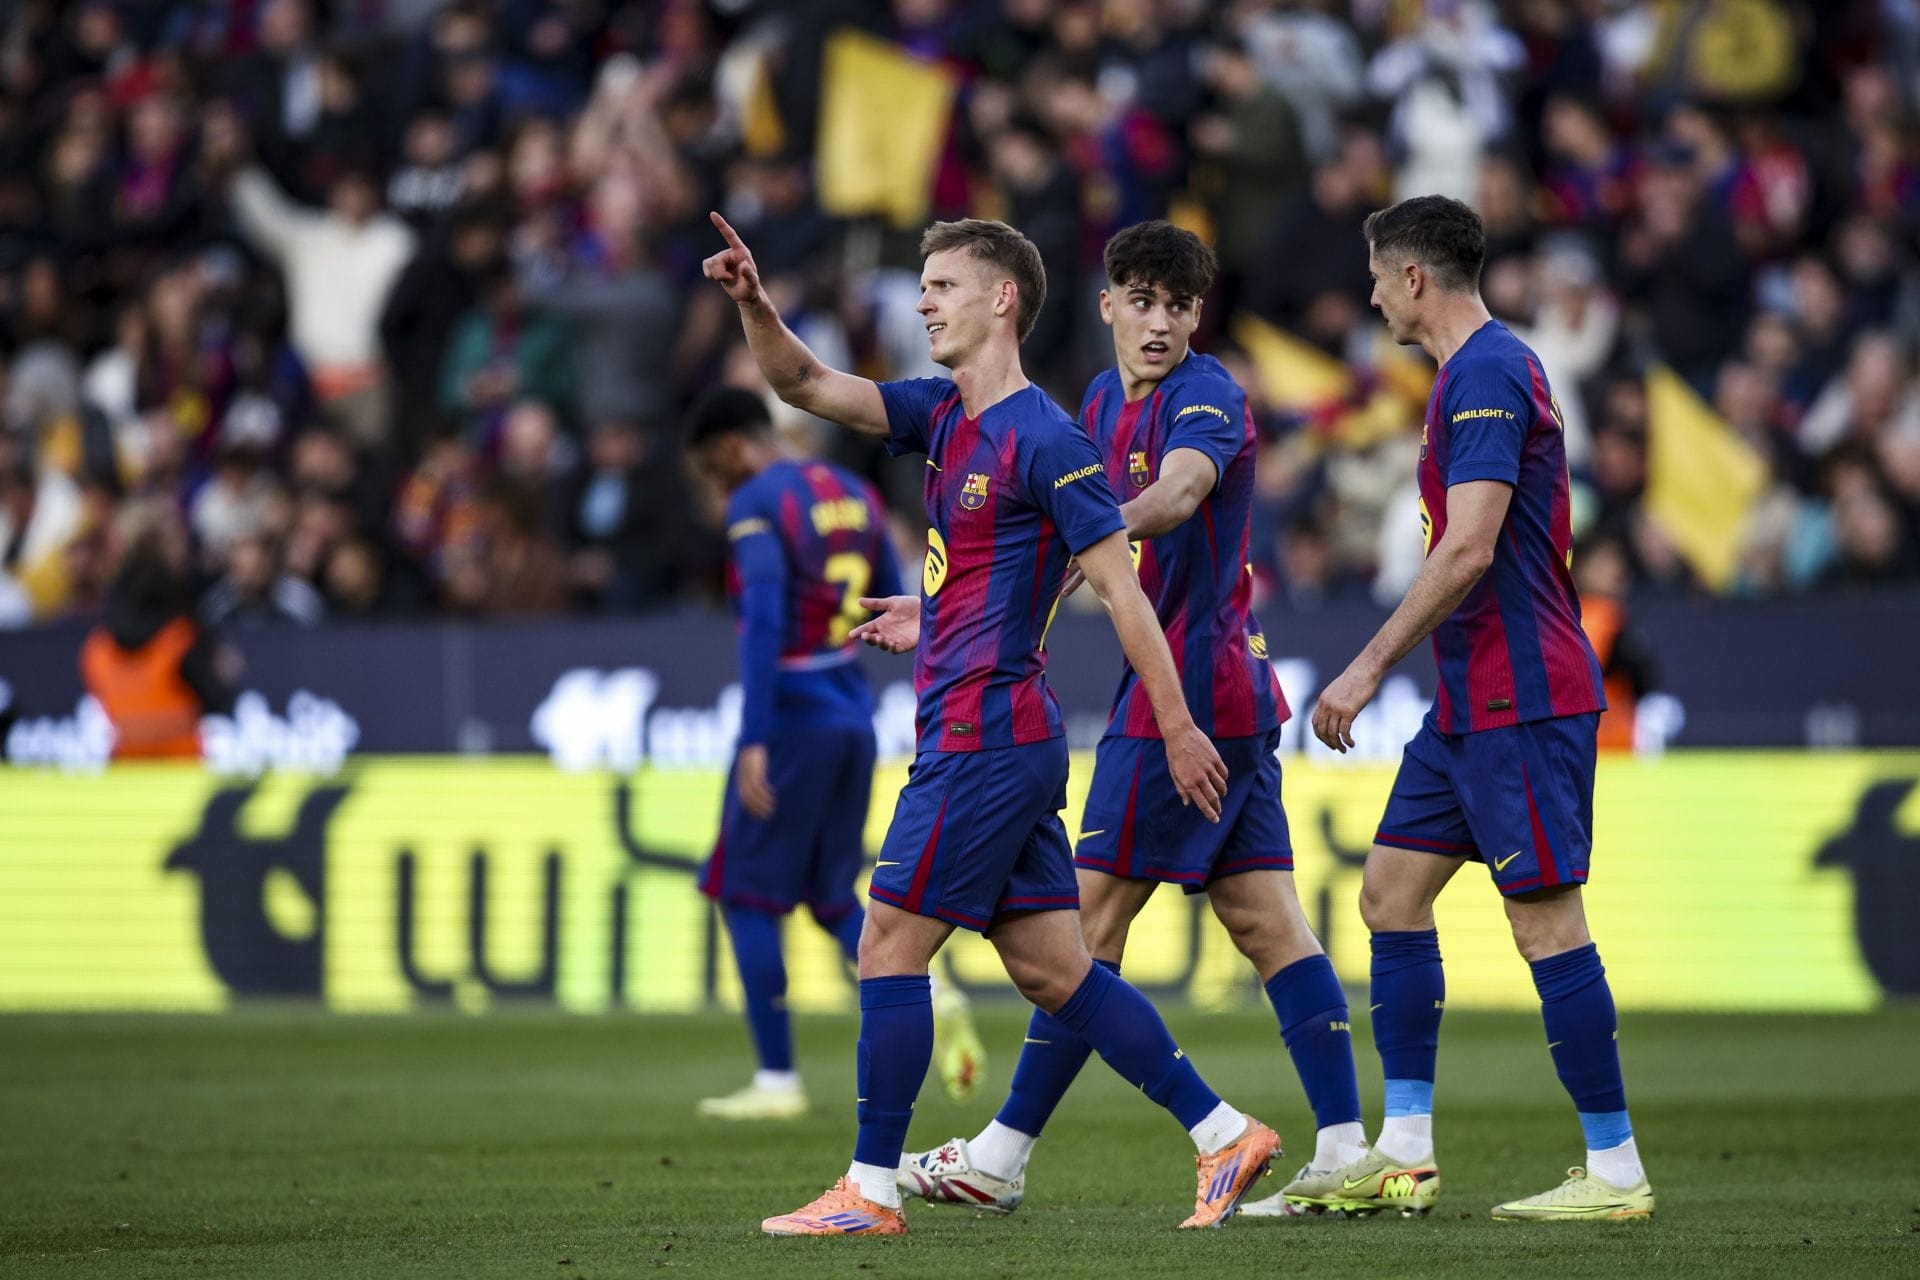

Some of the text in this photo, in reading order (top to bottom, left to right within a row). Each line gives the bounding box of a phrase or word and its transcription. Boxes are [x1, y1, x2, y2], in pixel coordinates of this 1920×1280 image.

[1452, 408, 1515, 424] AMBILIGHT tv
[1054, 463, 1100, 490] AMBILIGHT
